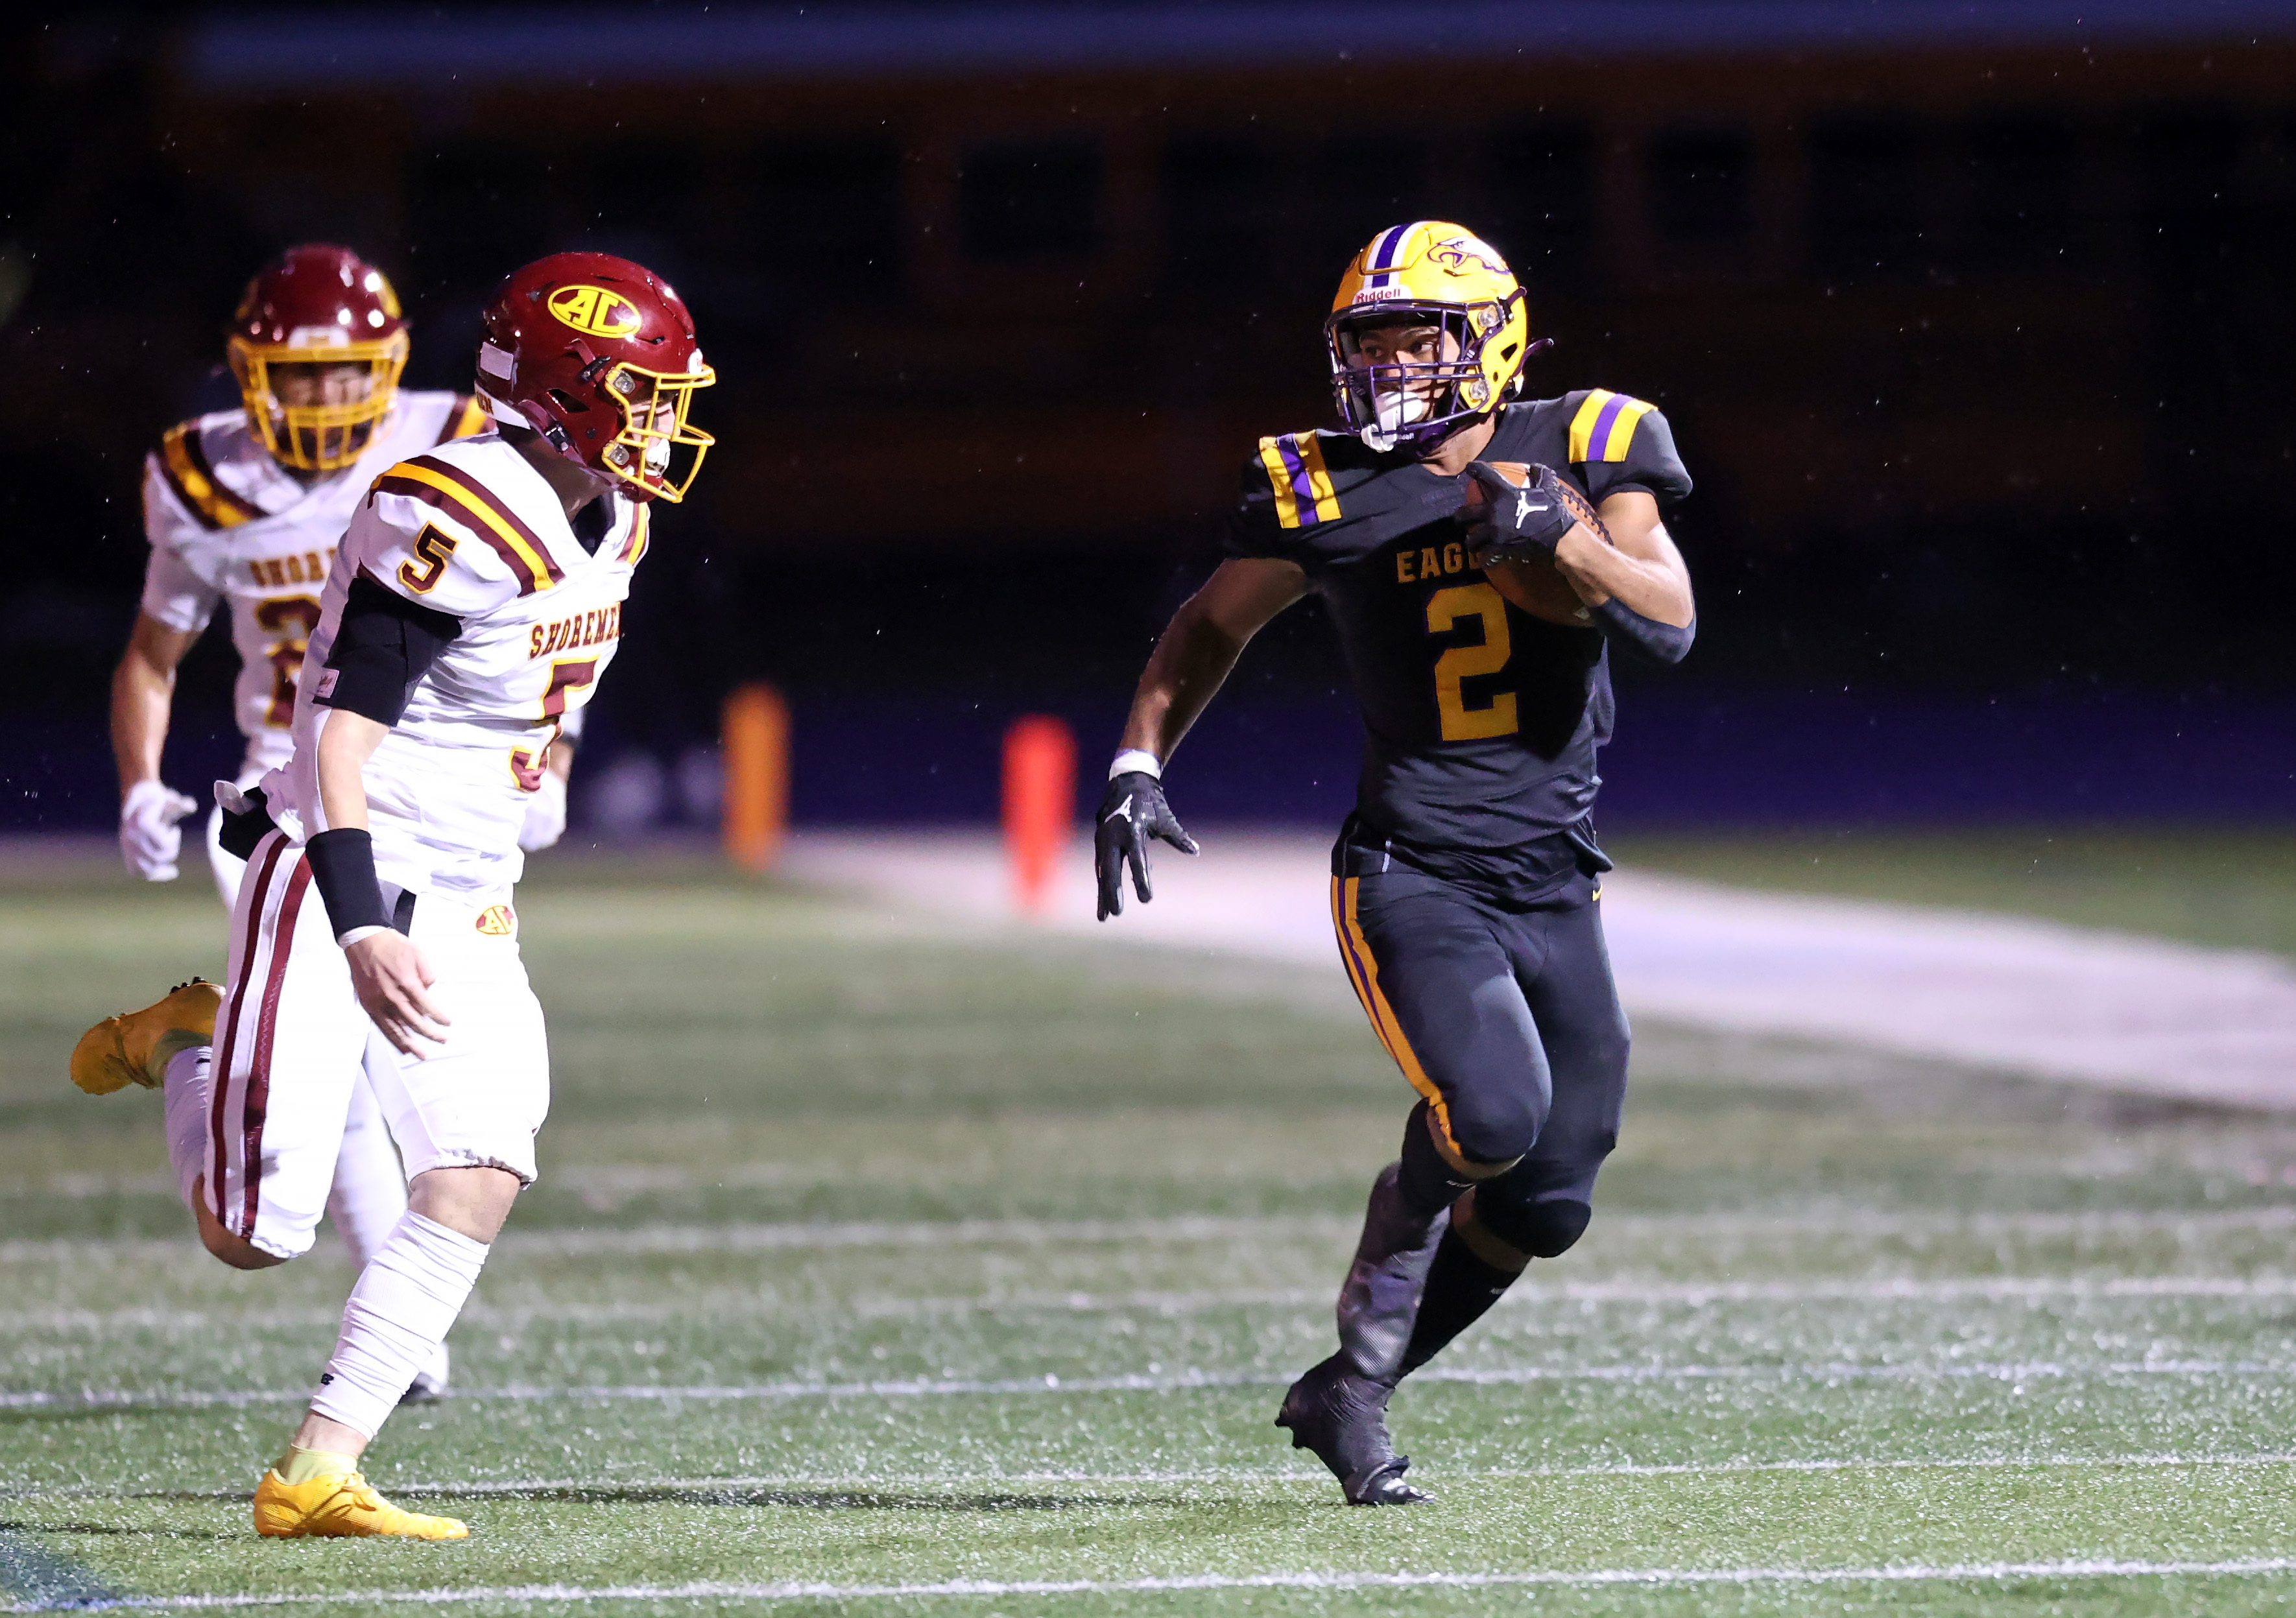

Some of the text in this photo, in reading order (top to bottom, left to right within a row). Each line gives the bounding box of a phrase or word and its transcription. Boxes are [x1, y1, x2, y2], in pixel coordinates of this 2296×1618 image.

[1357, 289, 1400, 303] Riddell
[397, 521, 460, 594] 5
[1426, 582, 1519, 741] 2
[508, 654, 601, 794] 5
